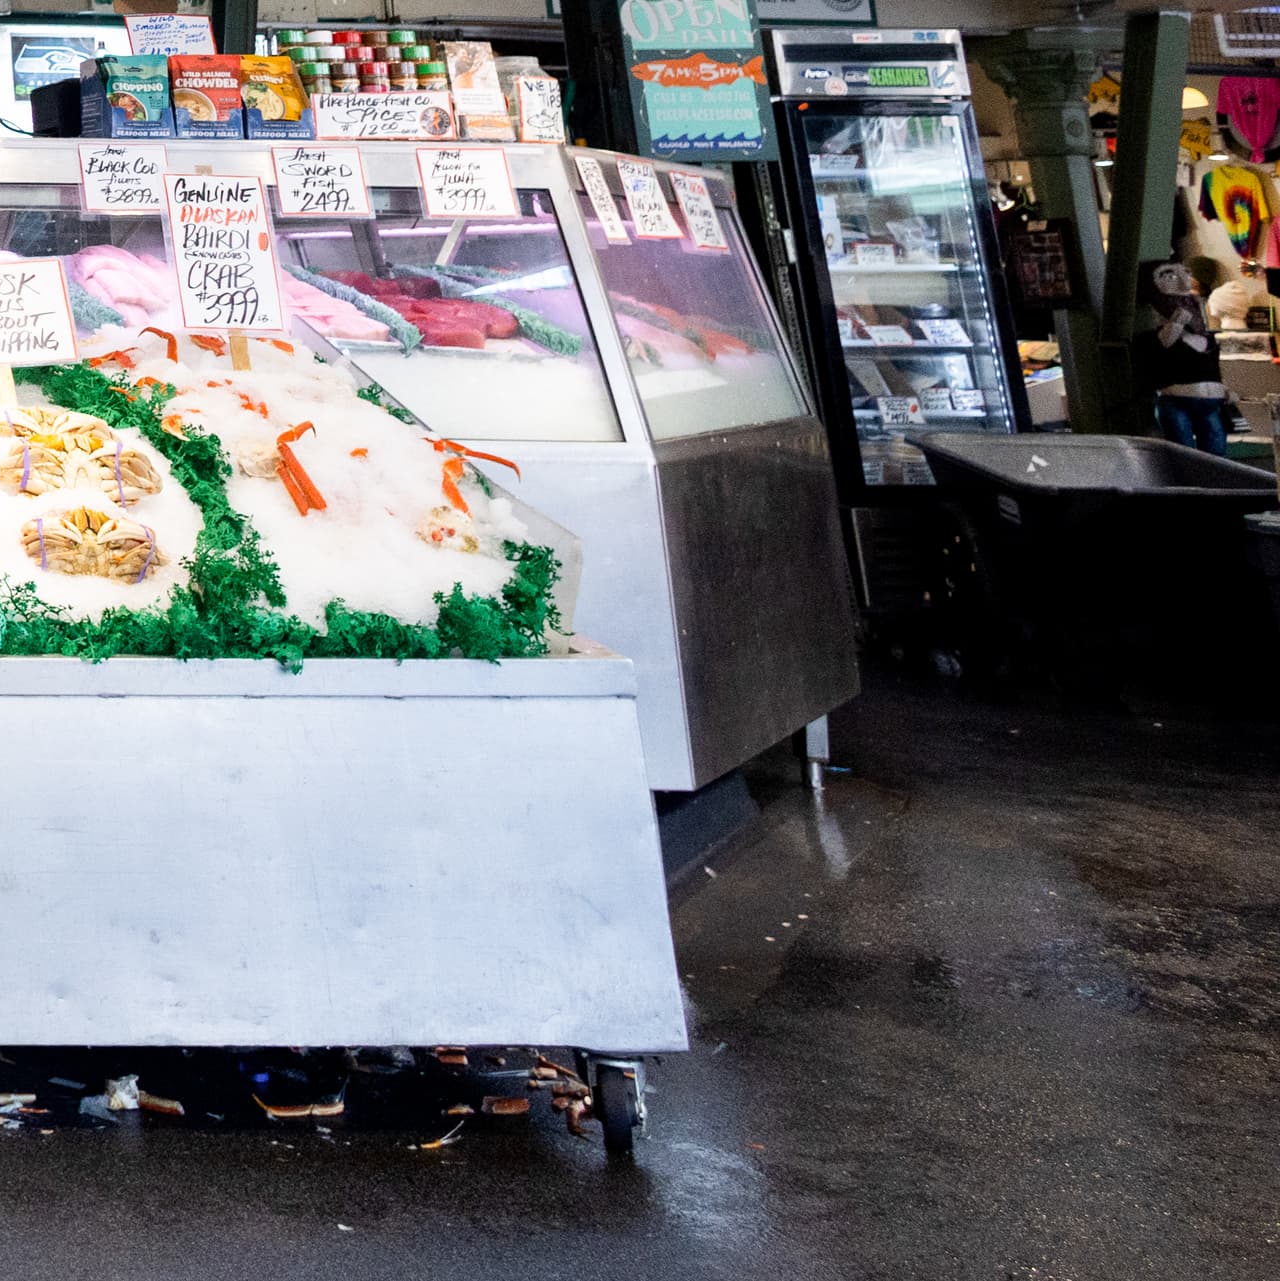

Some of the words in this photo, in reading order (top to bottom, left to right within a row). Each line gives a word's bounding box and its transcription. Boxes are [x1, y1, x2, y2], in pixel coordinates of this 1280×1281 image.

[175, 78, 238, 89] CHOWDER
[867, 67, 929, 87] SEAHAWKS
[112, 82, 164, 93] CIOPPINO
[524, 80, 545, 93] WE
[414, 94, 433, 106] CO.
[332, 109, 417, 124] SPICES
[85, 157, 132, 174] BLACK
[134, 159, 158, 174] COD
[282, 163, 353, 178] SWORD
[173, 177, 257, 204] GENUINE
[302, 178, 341, 191] FISH
[179, 204, 259, 225] ALASKAN
[183, 223, 251, 250] BAIRDI
[186, 261, 255, 290] CRAB
